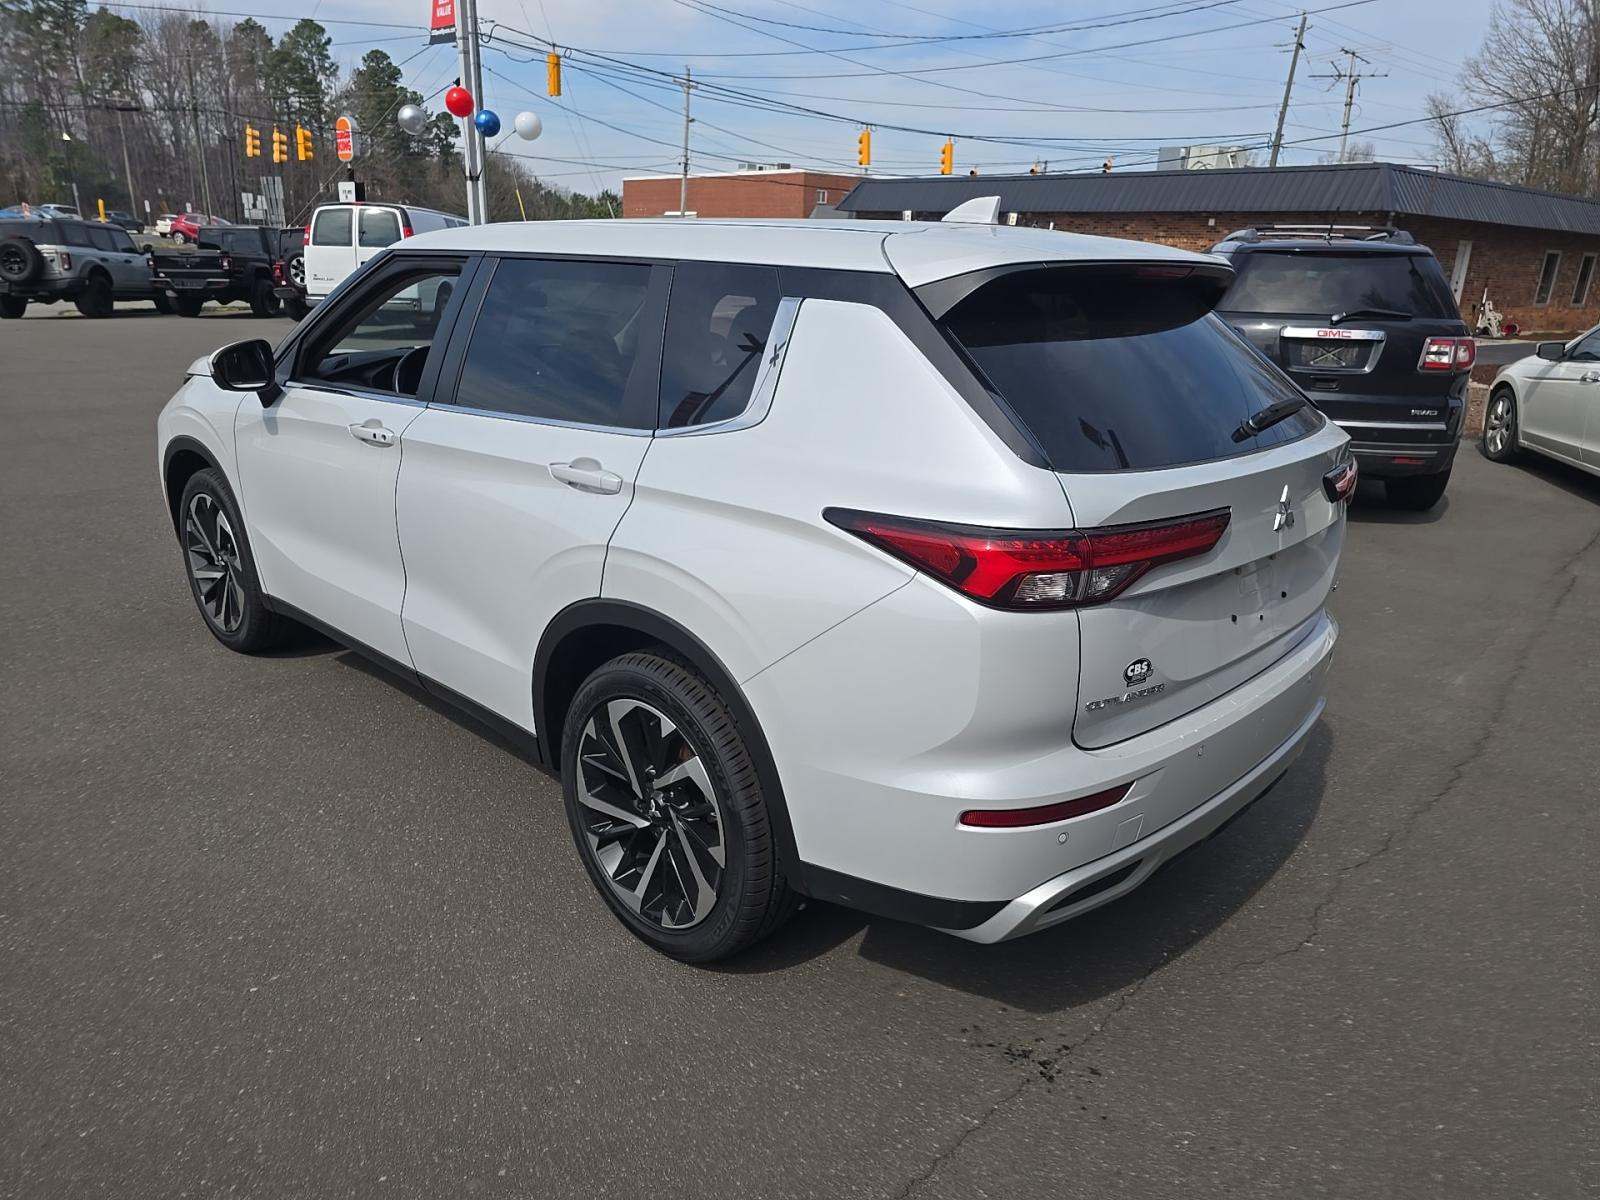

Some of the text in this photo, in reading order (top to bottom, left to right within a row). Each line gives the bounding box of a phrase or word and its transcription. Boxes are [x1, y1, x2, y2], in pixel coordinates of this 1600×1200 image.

[436, 5, 452, 17] VALUE
[1317, 330, 1352, 338] GMC
[1127, 661, 1148, 677] CBS
[1085, 683, 1166, 711] OUTLANDER
